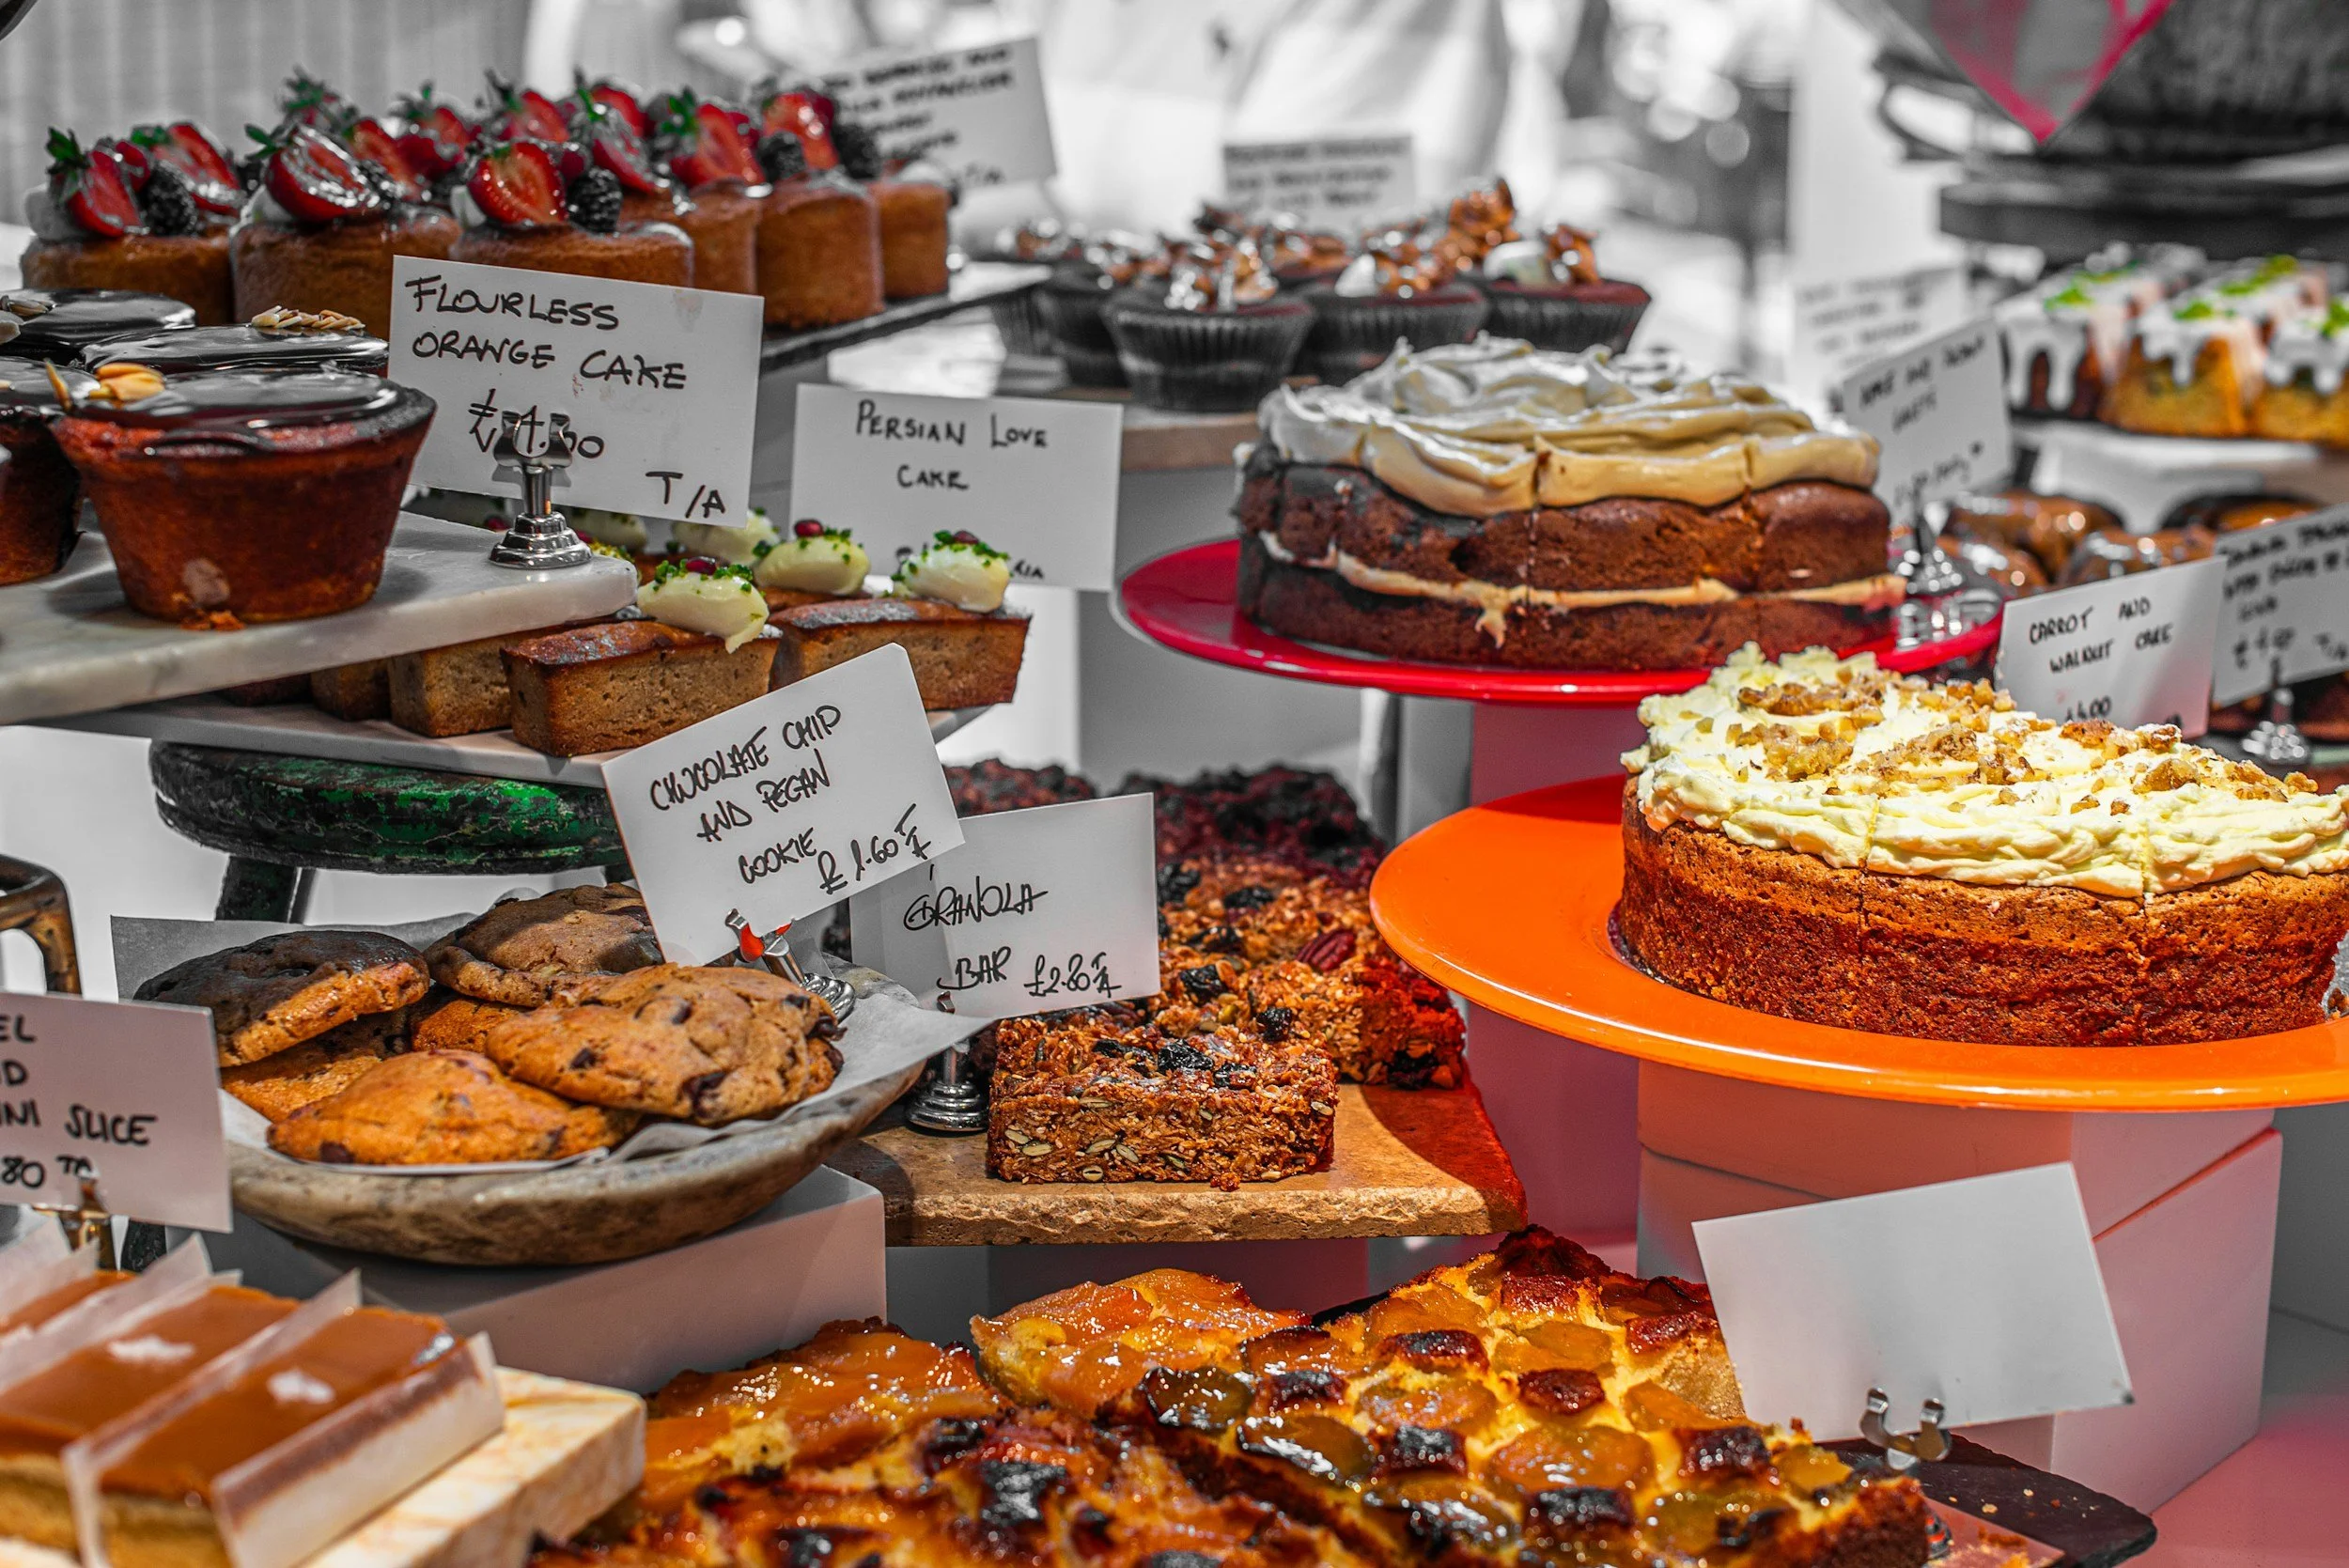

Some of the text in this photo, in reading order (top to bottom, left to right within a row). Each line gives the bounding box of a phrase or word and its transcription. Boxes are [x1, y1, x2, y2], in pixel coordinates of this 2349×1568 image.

[405, 273, 620, 331] FLOURLESS
[412, 330, 688, 391] ORANGE CAKE
[856, 398, 1048, 449] PERSIAN LOVE
[896, 463, 970, 491] CAKE
[2029, 606, 2094, 645] CARROT
[2049, 639, 2114, 674] WALNUT
[781, 704, 842, 751] CHIP
[696, 748, 831, 843] AND PECAN
[738, 826, 818, 884] COOKIE
[902, 875, 1050, 931] GRANOLA
[935, 945, 1012, 992] BAR
[65, 1103, 158, 1146] SLICE
